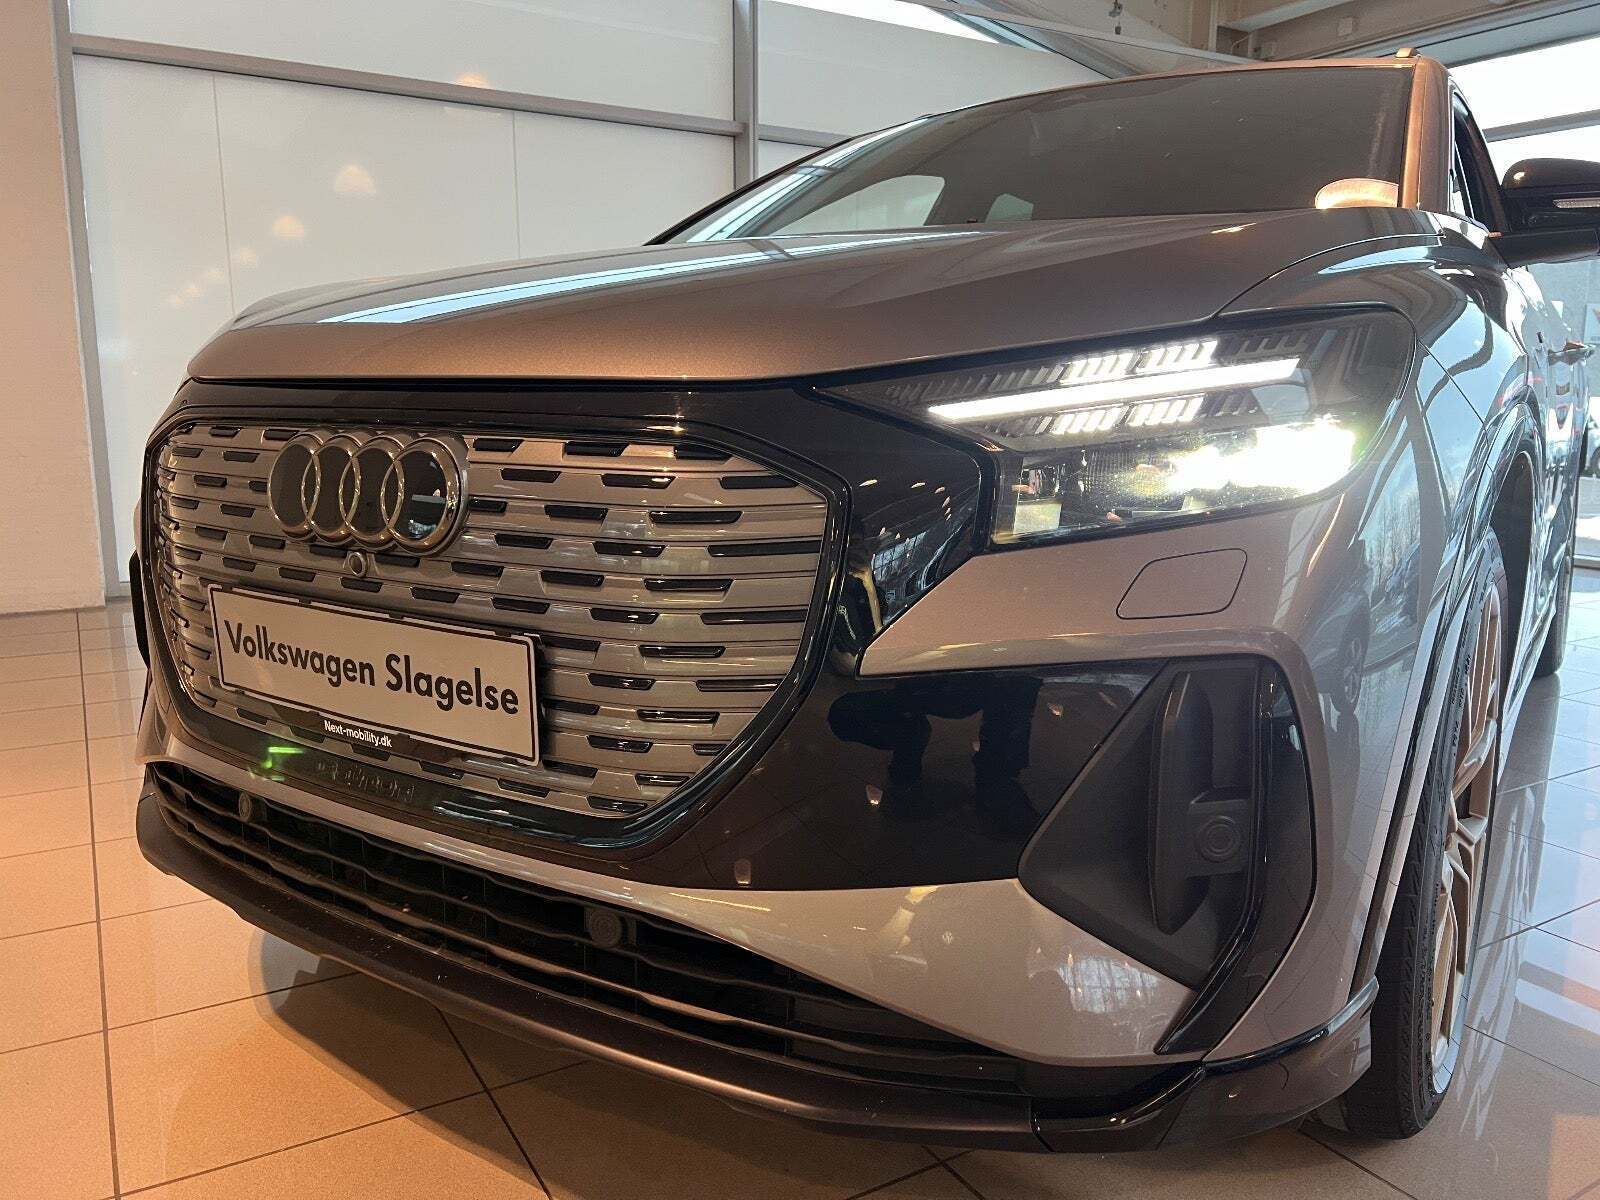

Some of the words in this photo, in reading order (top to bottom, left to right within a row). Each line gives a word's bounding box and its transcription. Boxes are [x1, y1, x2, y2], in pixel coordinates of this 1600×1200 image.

[224, 620, 376, 687] Volkswagen
[385, 654, 519, 714] Slagelse
[324, 720, 392, 747] Next-mobility.dk
